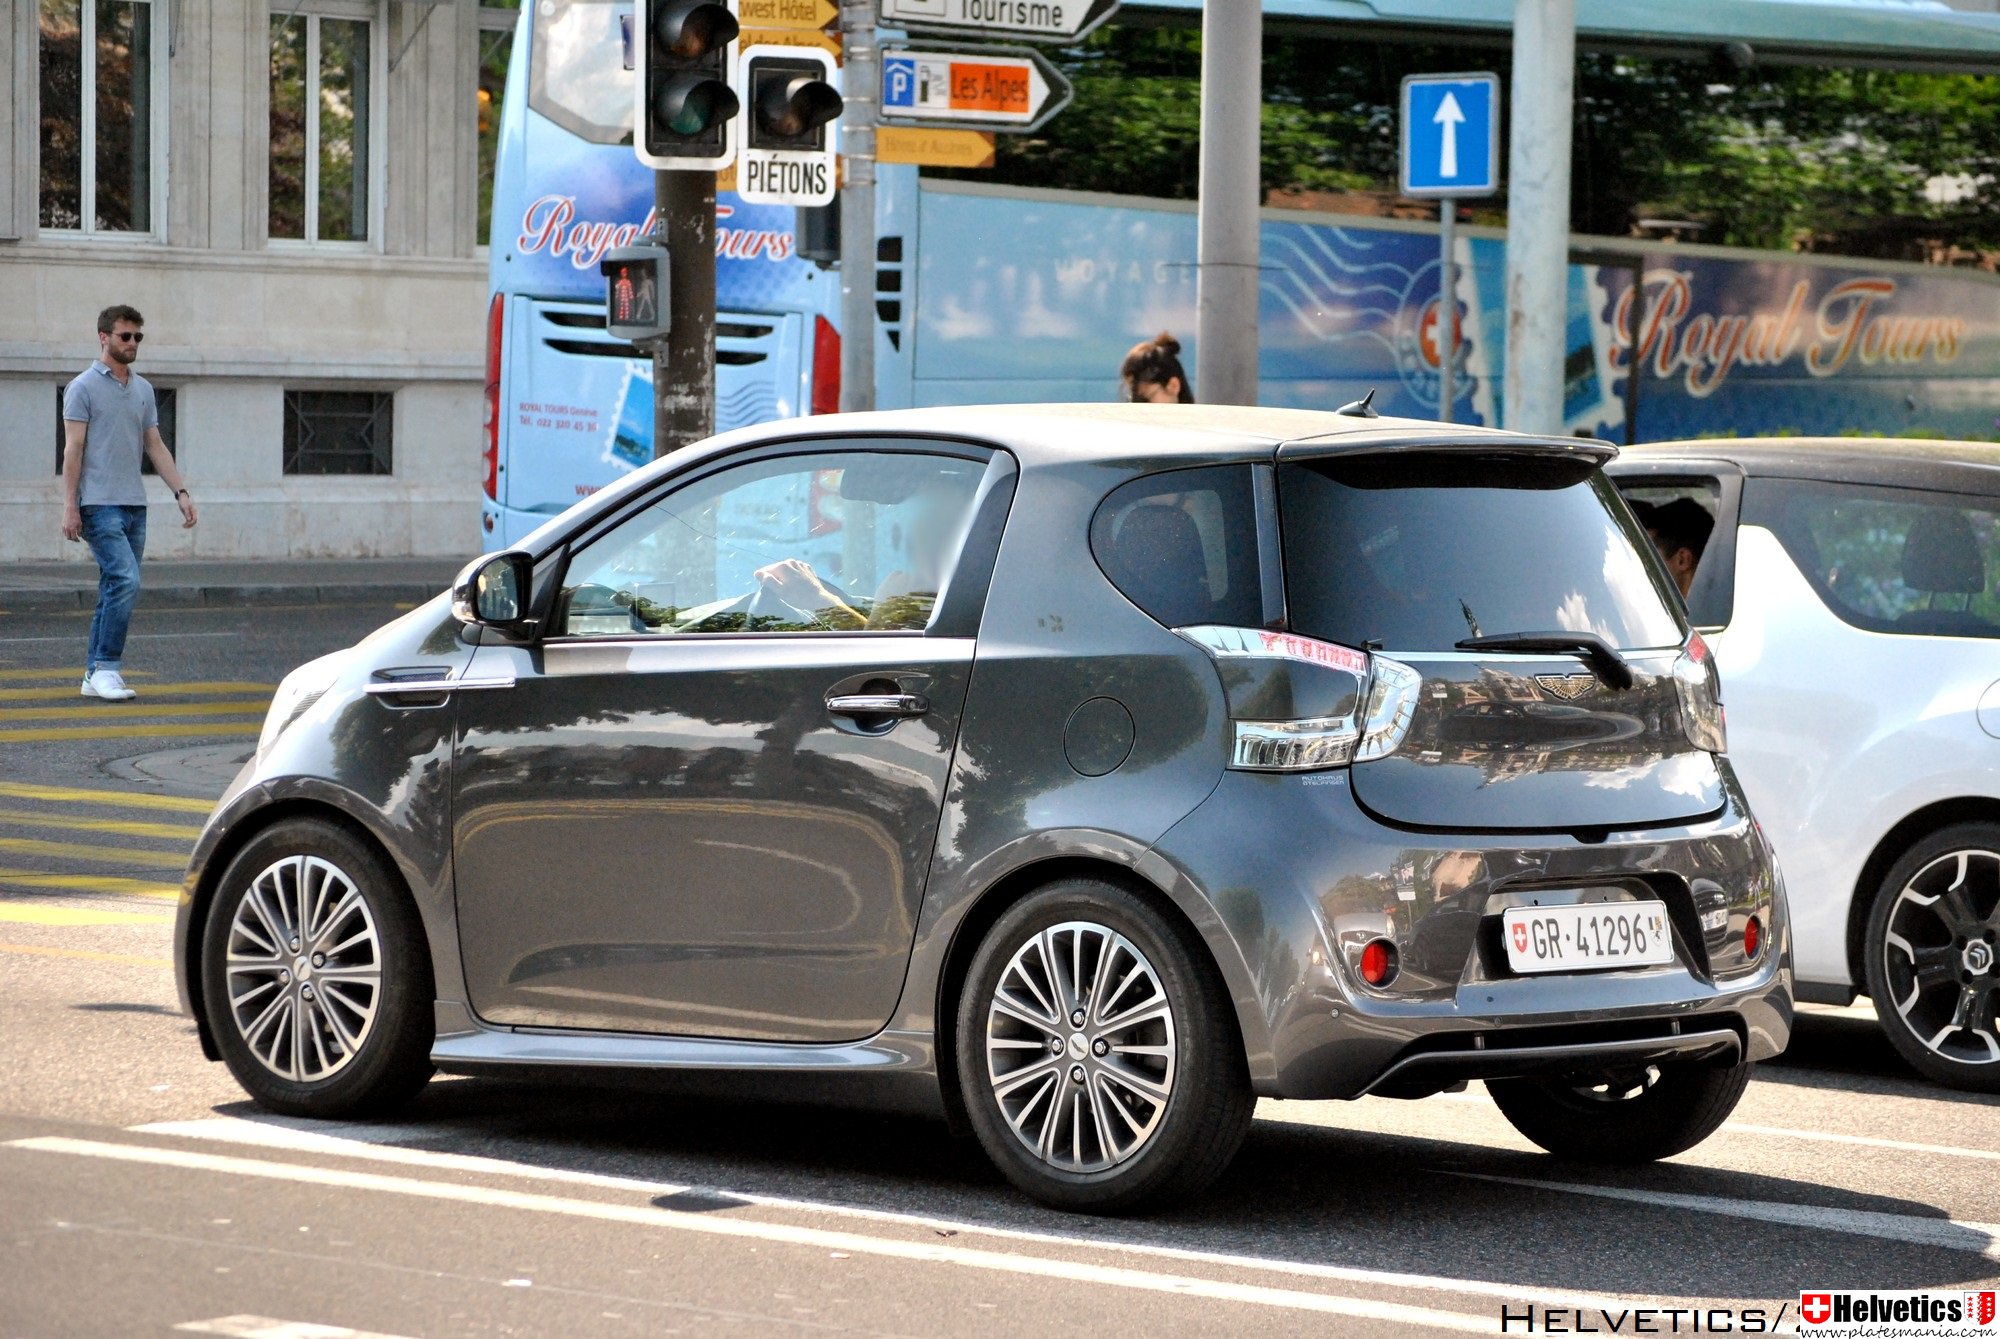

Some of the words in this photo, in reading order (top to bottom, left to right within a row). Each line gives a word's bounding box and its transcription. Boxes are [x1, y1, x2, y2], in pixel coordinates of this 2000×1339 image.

[952, 69, 979, 100] Les
[983, 70, 1028, 110] Alpes
[747, 153, 826, 195] PIÉTONS
[1607, 268, 1811, 398] Royal
[1804, 277, 1969, 377] Tours
